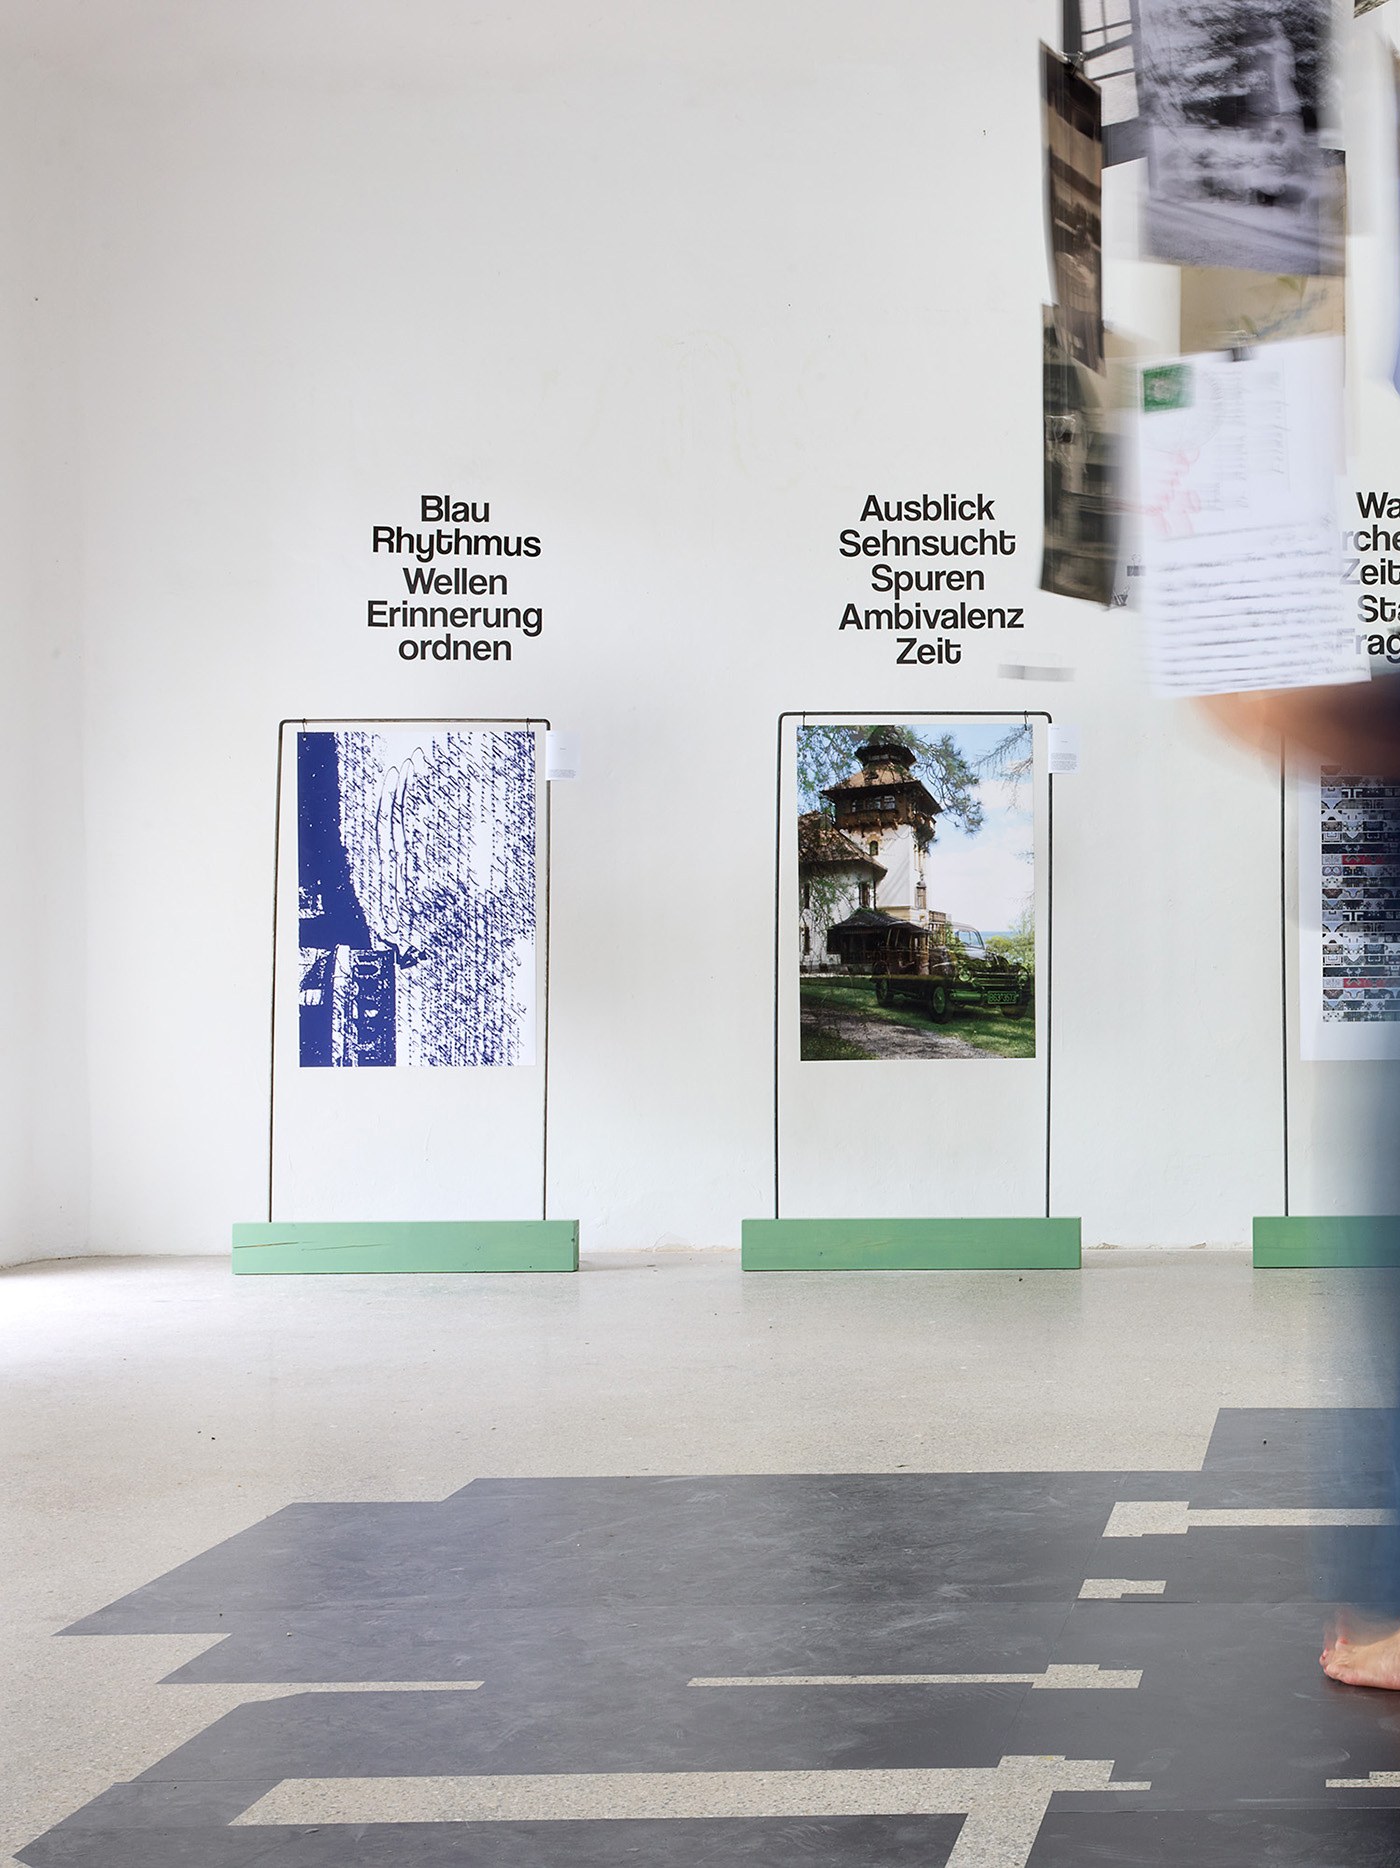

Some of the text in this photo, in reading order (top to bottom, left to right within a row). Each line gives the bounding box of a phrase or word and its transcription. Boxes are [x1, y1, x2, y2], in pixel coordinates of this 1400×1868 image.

[421, 494, 490, 523] Blau
[859, 493, 996, 522] Ausblick
[372, 525, 542, 564] Rhythmus
[839, 528, 1016, 558] Sehnsucht
[403, 567, 508, 596] Wellen
[871, 563, 985, 601] Spuren
[367, 600, 543, 638] Erinnerung
[838, 602, 1025, 631] Ambivalenz
[398, 633, 512, 661] ordnen
[896, 637, 962, 665] Zeit
